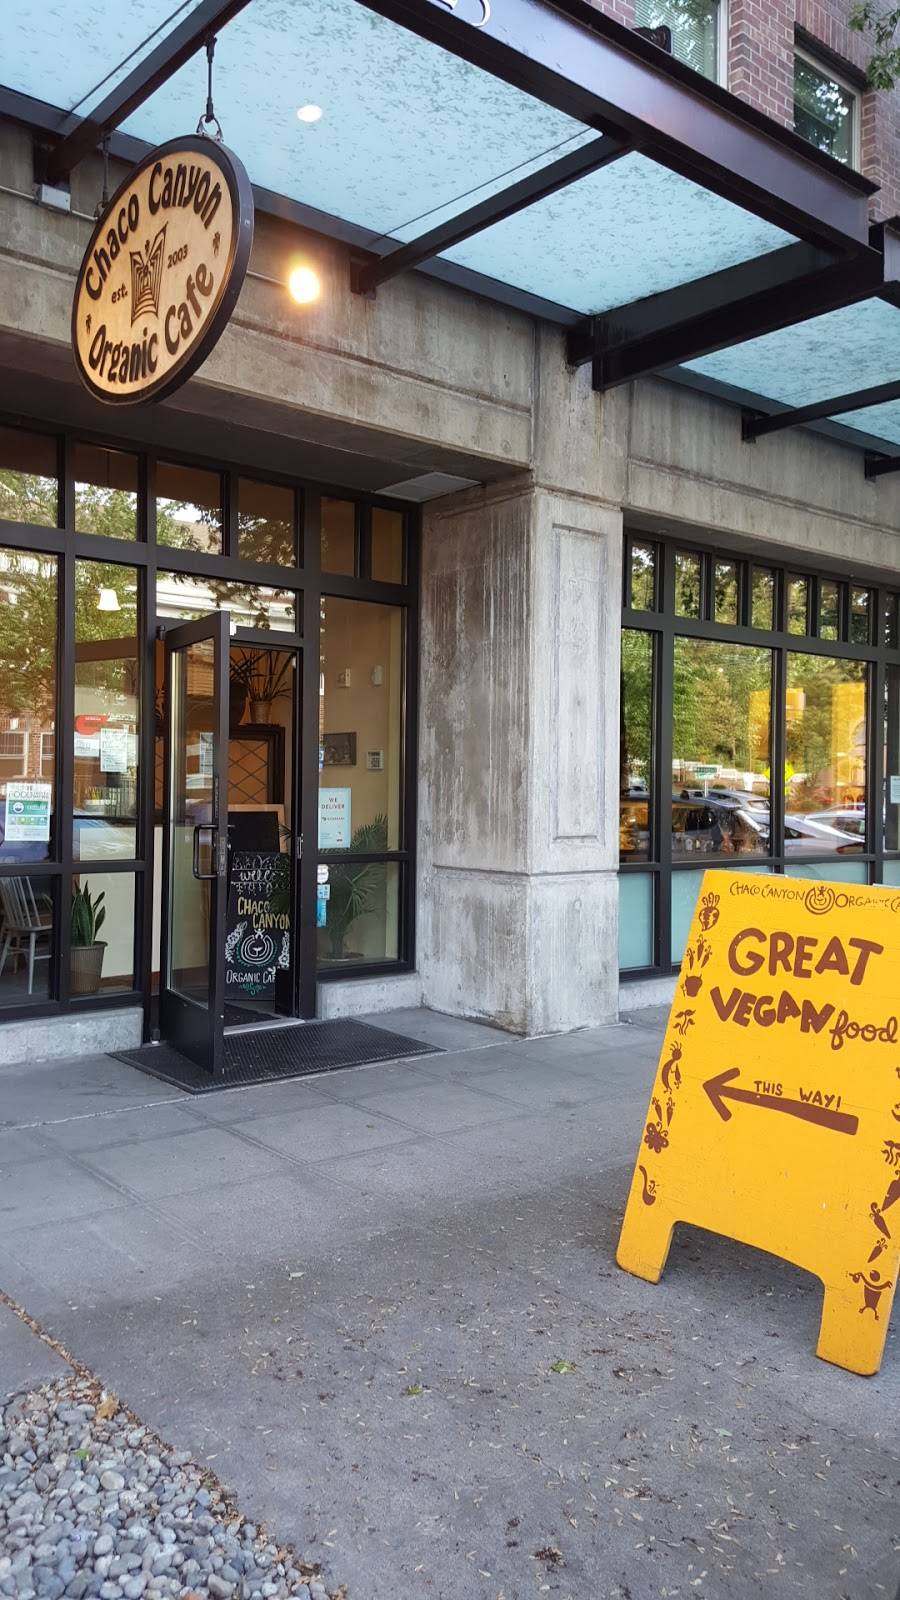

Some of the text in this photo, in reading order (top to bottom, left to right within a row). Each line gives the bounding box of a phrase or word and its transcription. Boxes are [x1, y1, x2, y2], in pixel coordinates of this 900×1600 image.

[85, 161, 222, 301] Chaco Canyon
[167, 243, 188, 270] 2003
[88, 262, 214, 384] Organic Cafe
[729, 881, 760, 897] CHACO
[760, 883, 806, 901] CANYON
[237, 896, 270, 916] CHACO
[252, 912, 290, 930] CANYON
[728, 927, 884, 986] GREAT
[226, 970, 276, 985] ORGANIC CAF
[709, 986, 899, 1050] VEGAN food
[753, 1080, 842, 1112] THIS WAY!
